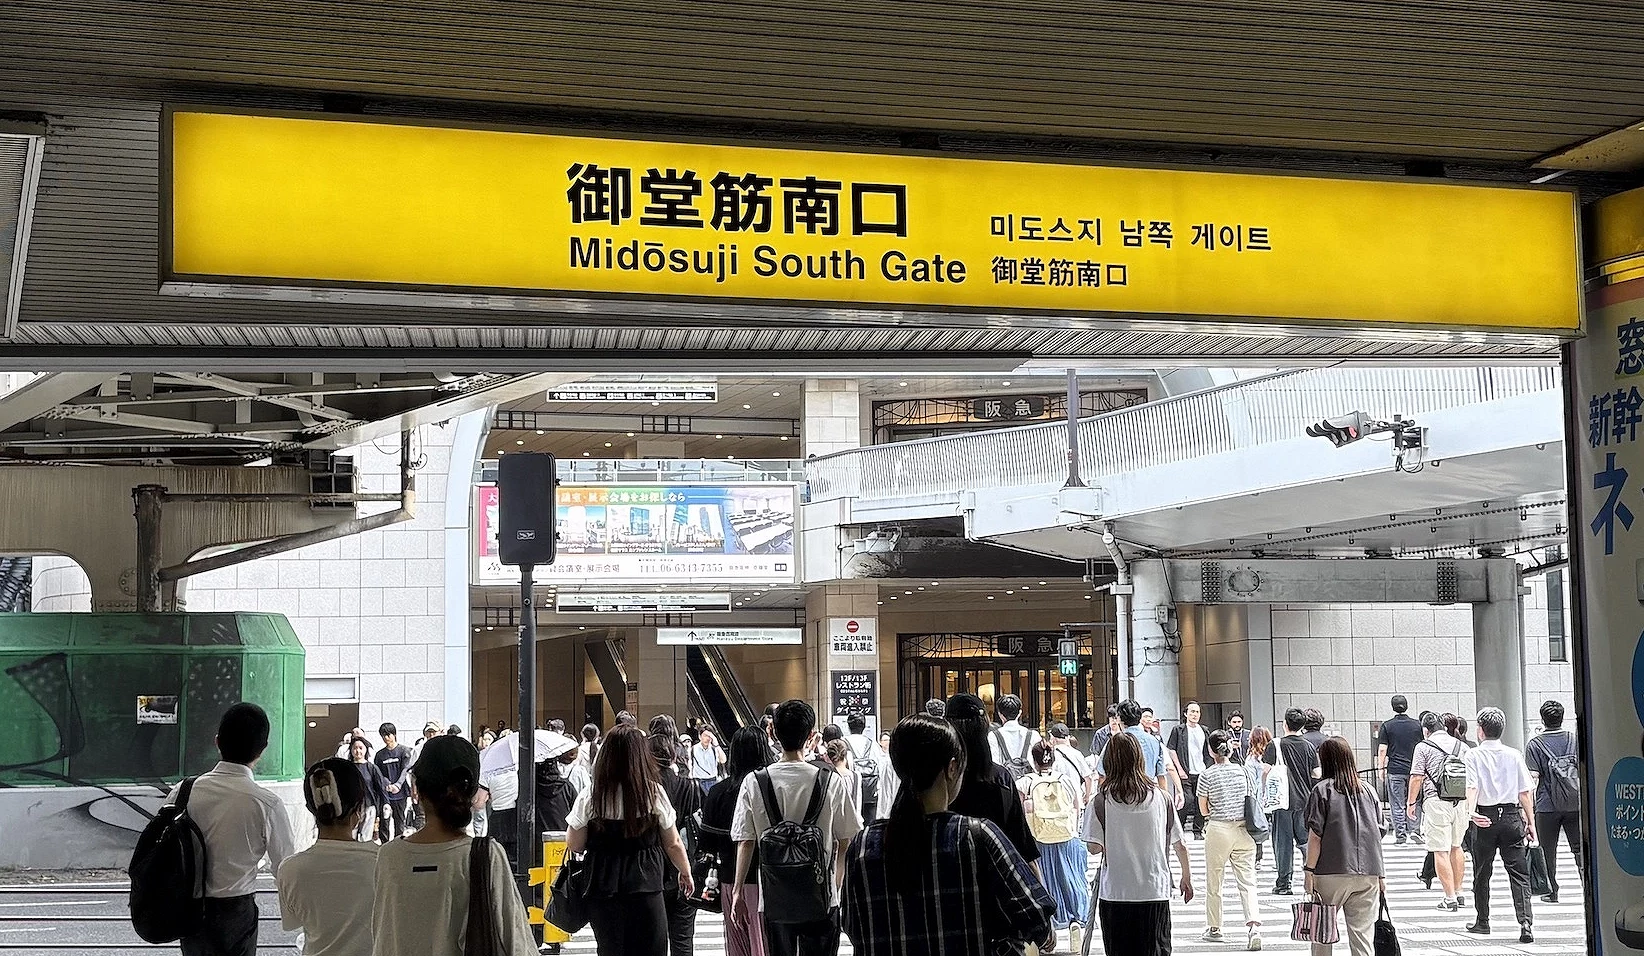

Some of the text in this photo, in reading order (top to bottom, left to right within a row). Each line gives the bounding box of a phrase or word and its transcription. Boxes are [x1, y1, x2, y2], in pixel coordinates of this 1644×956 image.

[566, 162, 908, 238] 御堂筋南口
[990, 213, 1272, 252] 미도스지 남쪽 게이트
[569, 236, 967, 284] Midōsuji South Gate
[991, 256, 1128, 288] 御堂筋南口
[984, 399, 1032, 418] 阪急
[1588, 386, 1643, 449] 新幹
[1008, 637, 1054, 654] 阪急
